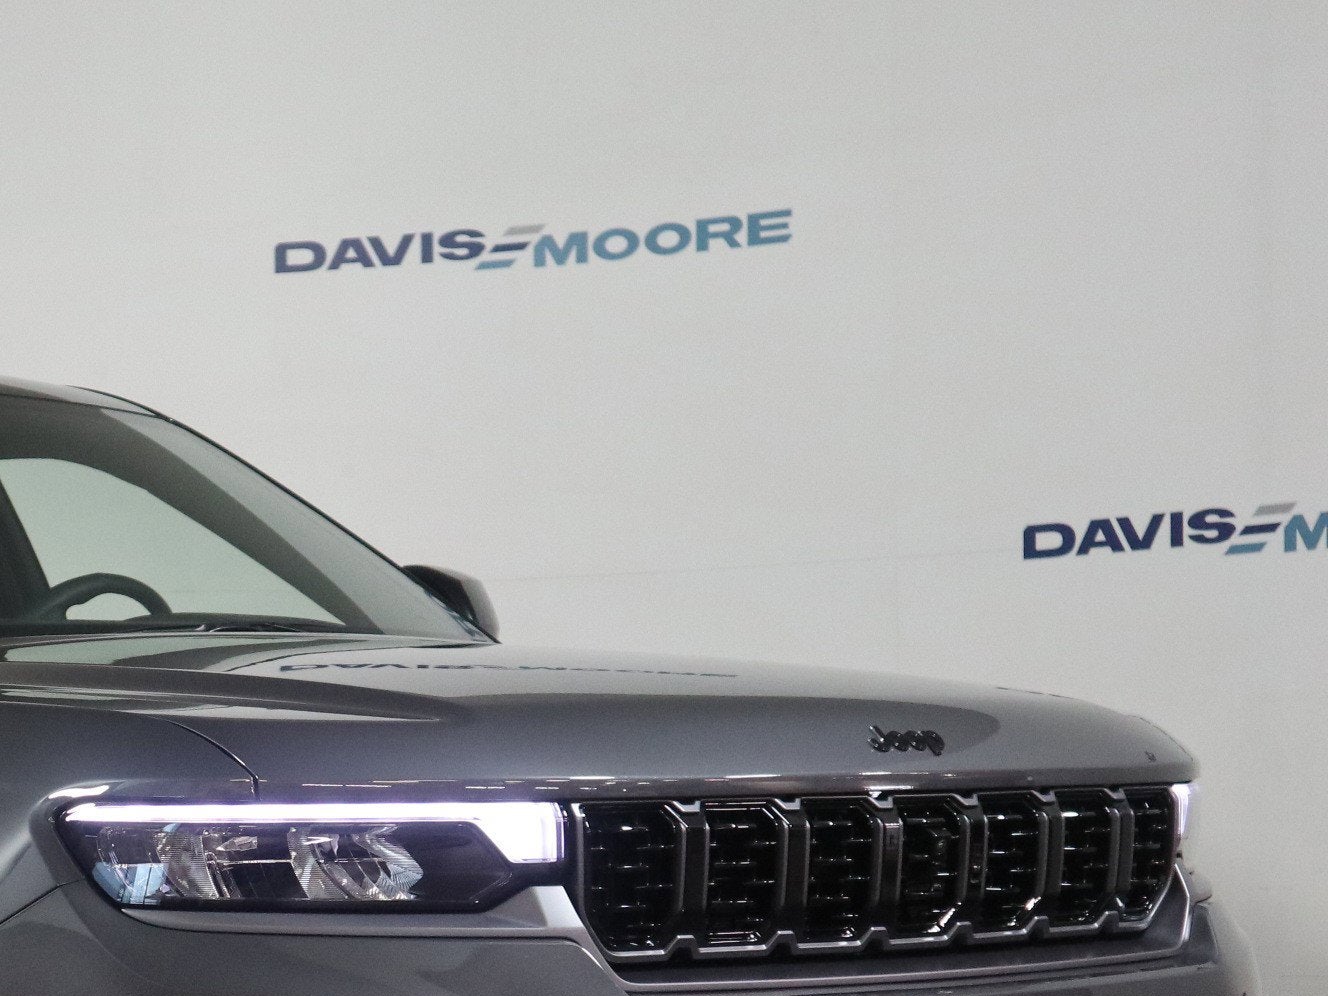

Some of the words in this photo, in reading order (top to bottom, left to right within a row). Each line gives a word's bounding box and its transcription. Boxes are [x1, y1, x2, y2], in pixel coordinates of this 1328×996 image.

[273, 228, 487, 274] DAVIS
[533, 208, 793, 268] MOORE
[1022, 507, 1237, 561] DAVIS
